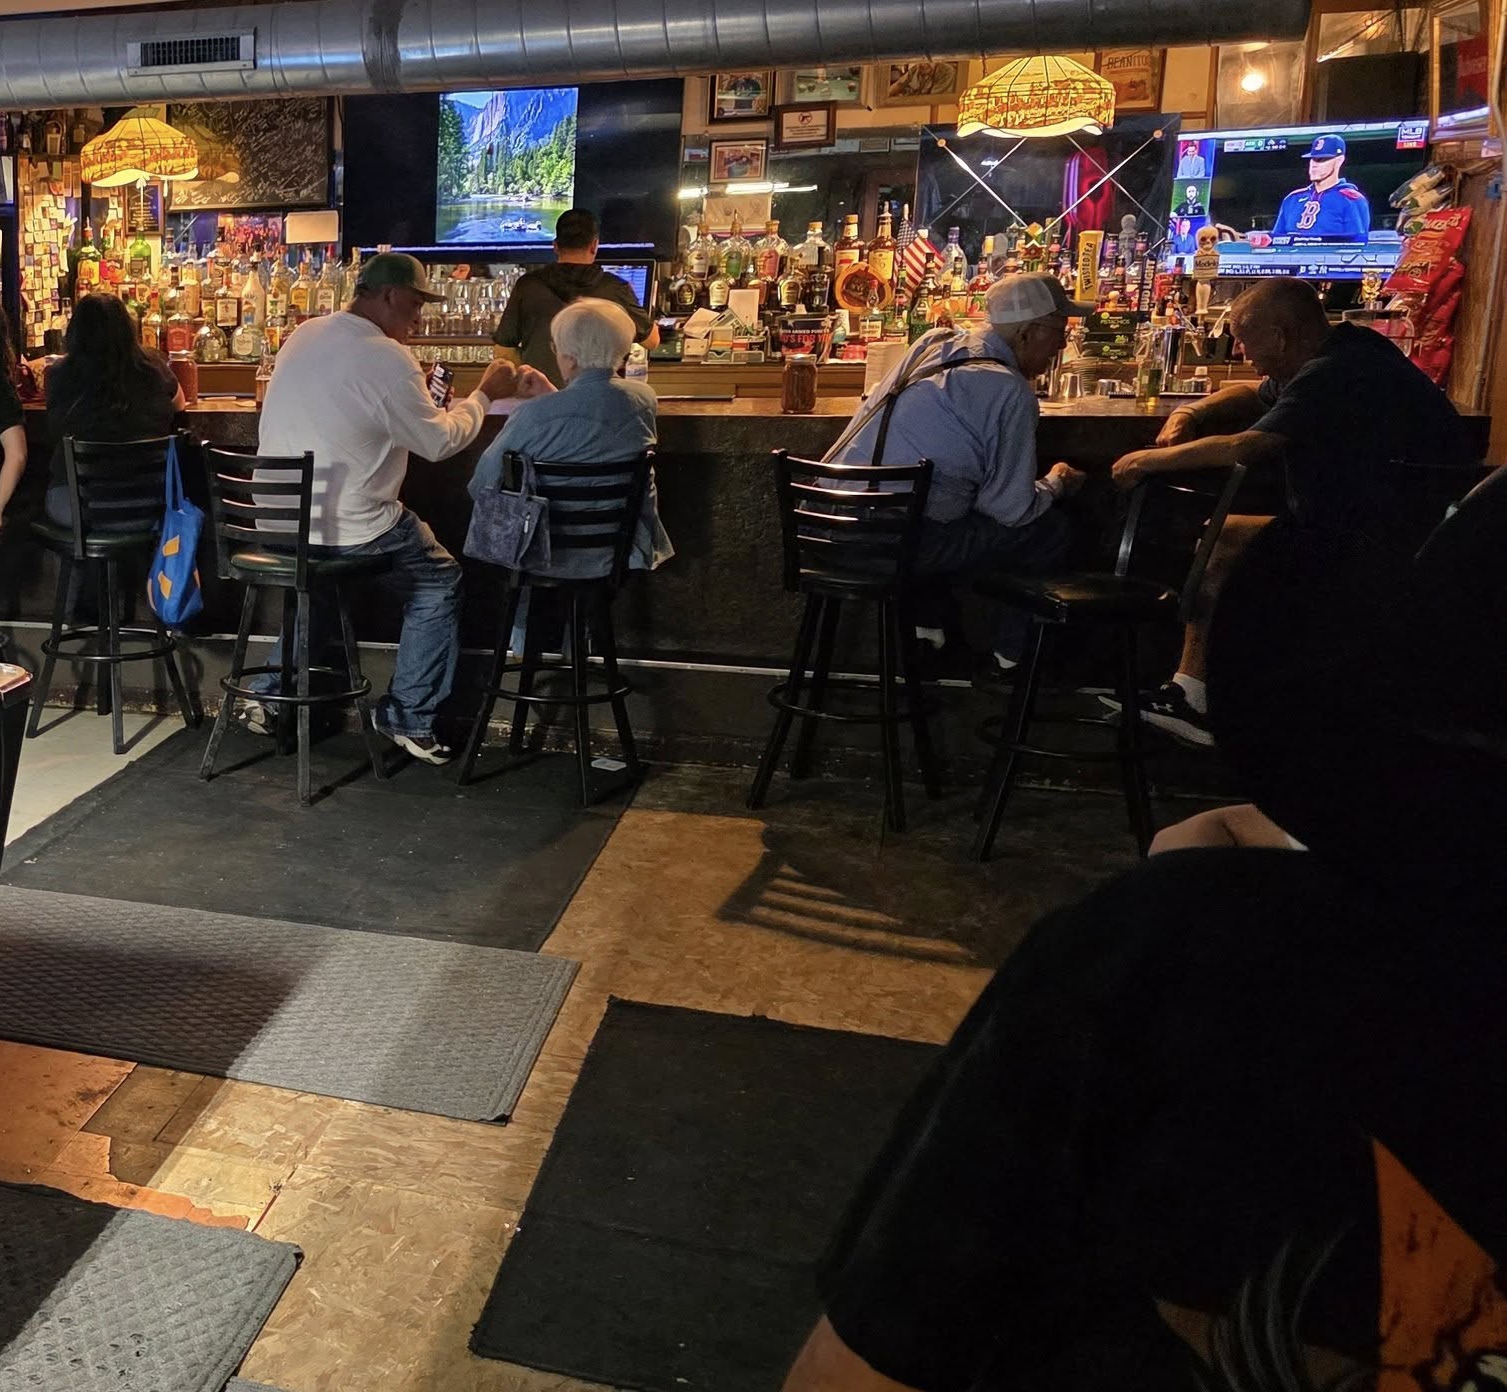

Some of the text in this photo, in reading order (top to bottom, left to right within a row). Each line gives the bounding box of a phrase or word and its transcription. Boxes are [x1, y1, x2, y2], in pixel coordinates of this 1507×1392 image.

[1401, 127, 1422, 136] MLB
[1082, 257, 1094, 291] TWISTED
[1140, 260, 1155, 311] BUD LIGHT
